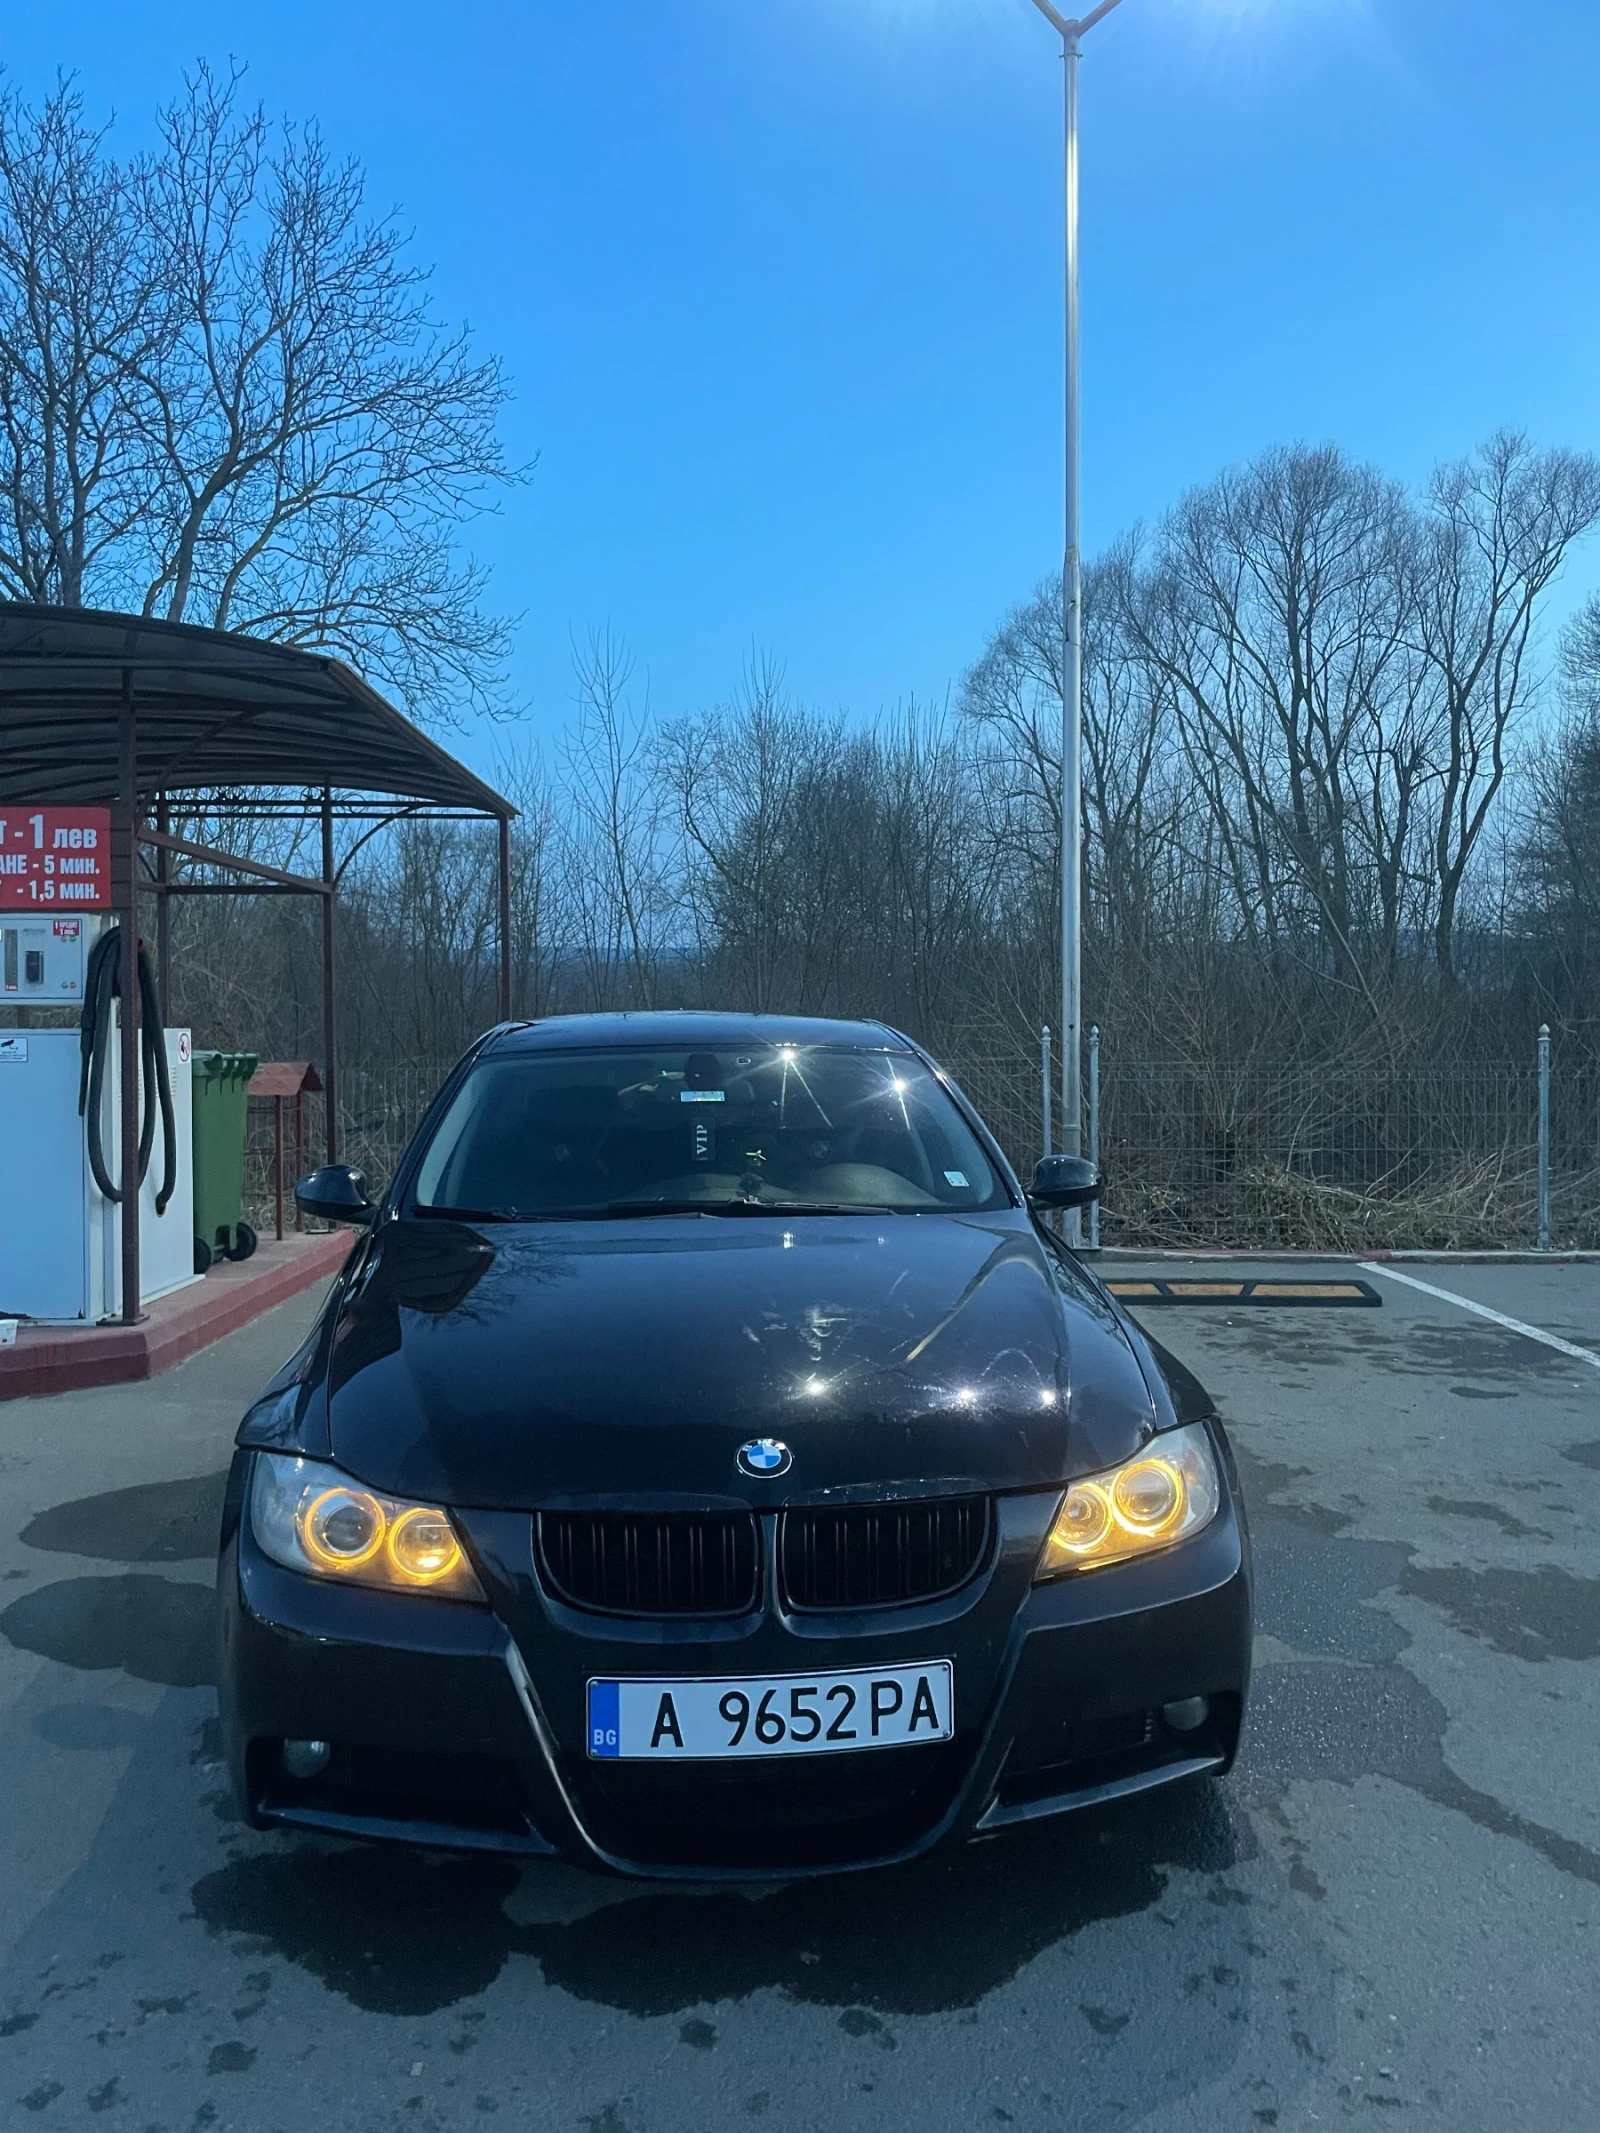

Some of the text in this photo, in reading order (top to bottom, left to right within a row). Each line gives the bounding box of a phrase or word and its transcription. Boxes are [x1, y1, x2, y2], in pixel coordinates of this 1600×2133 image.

[29, 814, 43, 848] 1
[53, 828, 97, 848] лев
[44, 855, 55, 874] 5
[29, 880, 55, 902] 1,5
[696, 1125, 707, 1155] VIP
[650, 1677, 940, 1748] A 9652 PA
[594, 1729, 617, 1746] BG
